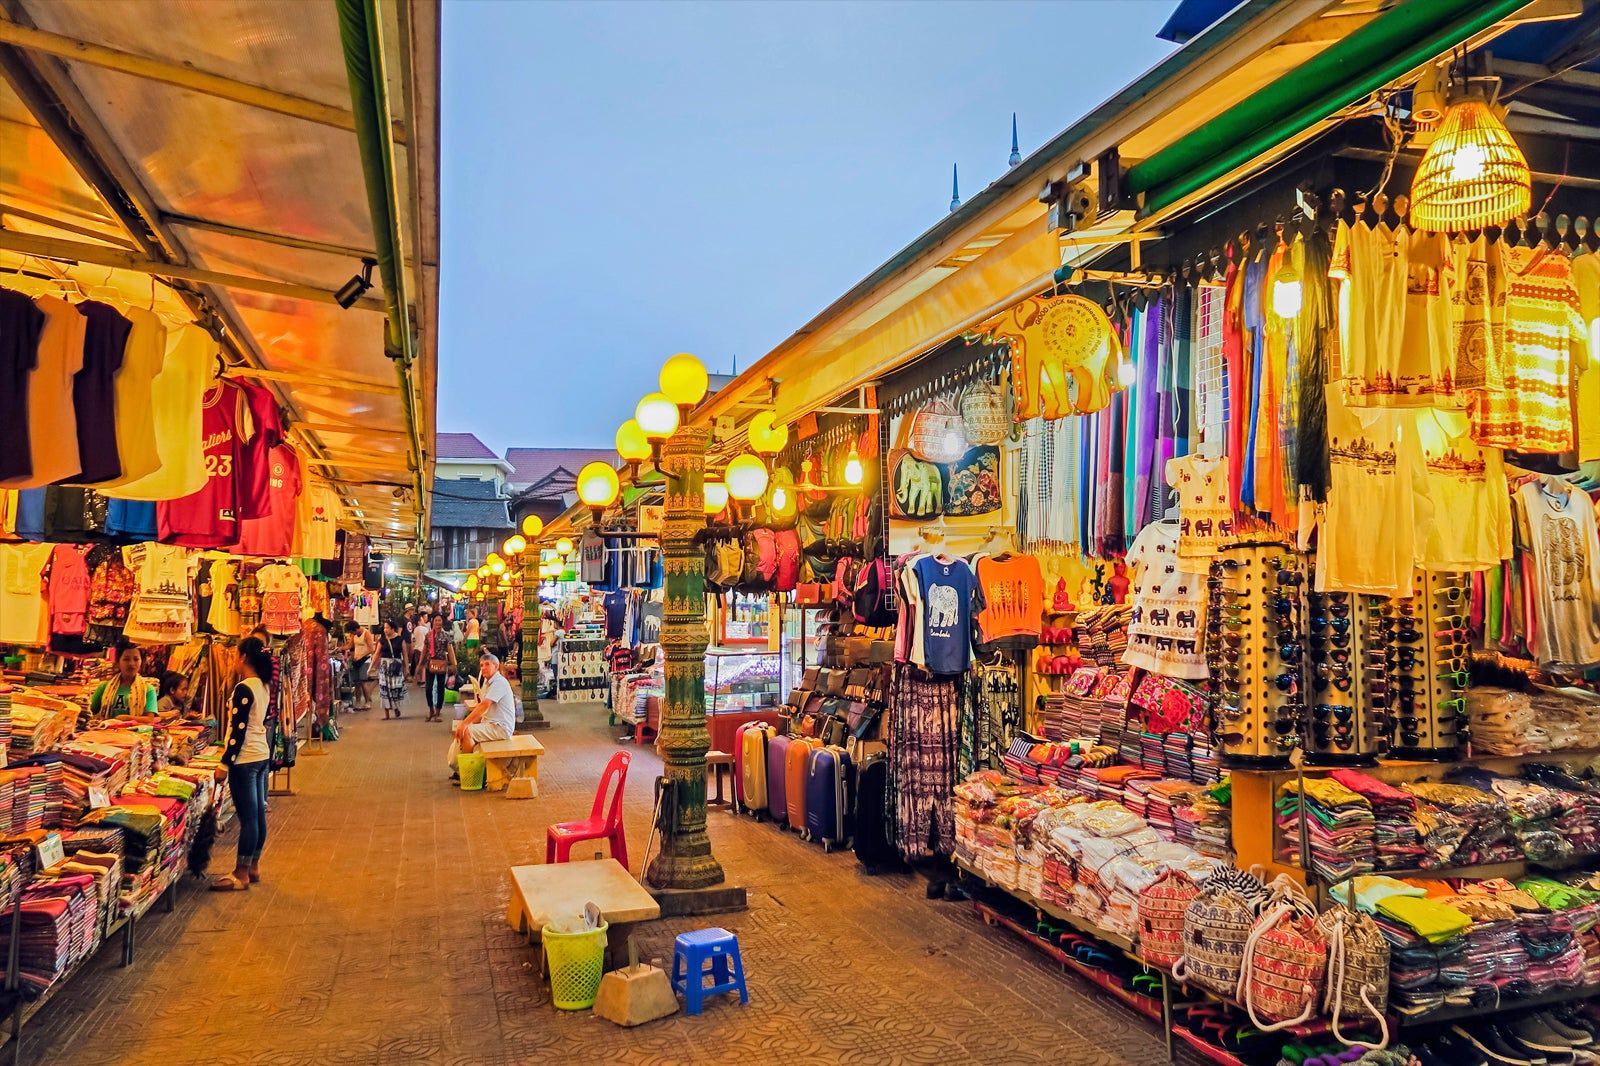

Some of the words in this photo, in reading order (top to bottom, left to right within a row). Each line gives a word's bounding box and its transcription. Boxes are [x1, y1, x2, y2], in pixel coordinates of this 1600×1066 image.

[1035, 306, 1049, 326] GOOD
[1047, 299, 1066, 310] LUCK
[205, 454, 233, 477] 23
[113, 694, 126, 709] A
